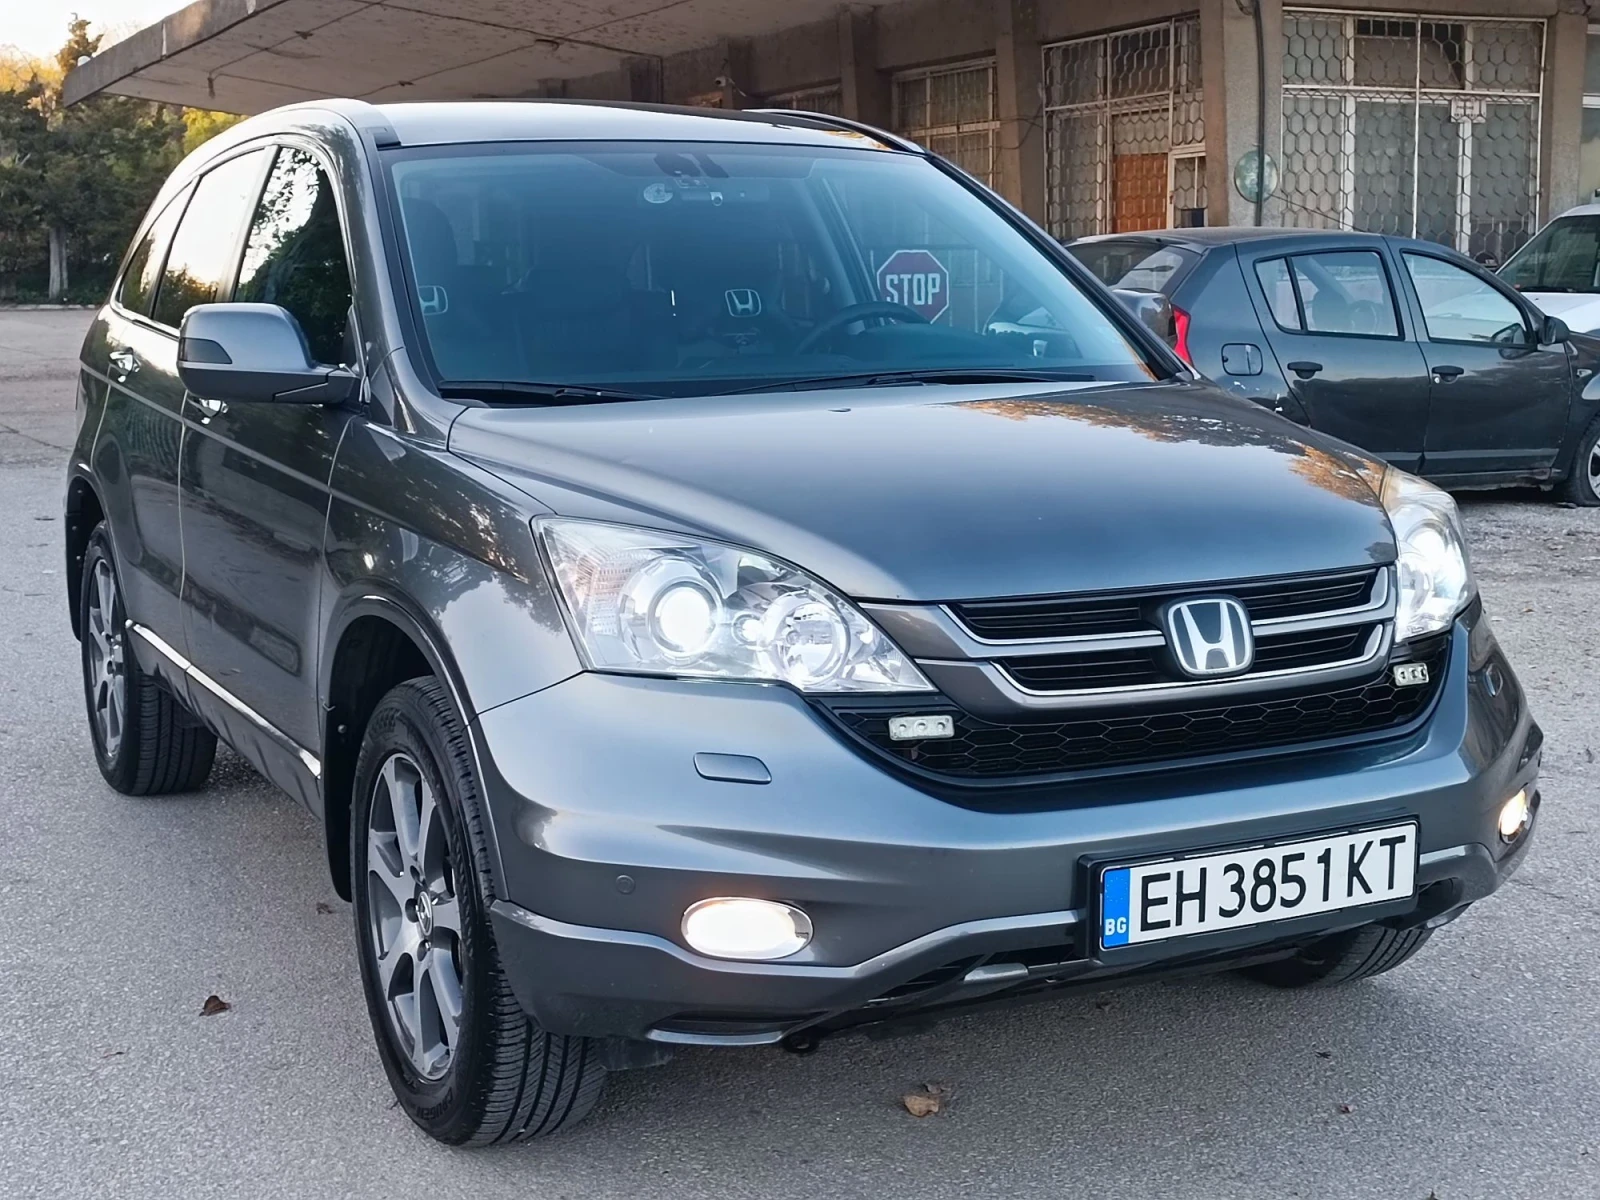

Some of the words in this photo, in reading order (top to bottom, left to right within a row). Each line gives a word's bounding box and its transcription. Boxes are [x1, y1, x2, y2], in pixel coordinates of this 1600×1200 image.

[885, 273, 941, 306] STOP
[1218, 848, 1331, 918] 3851
[1105, 917, 1127, 936] BG
